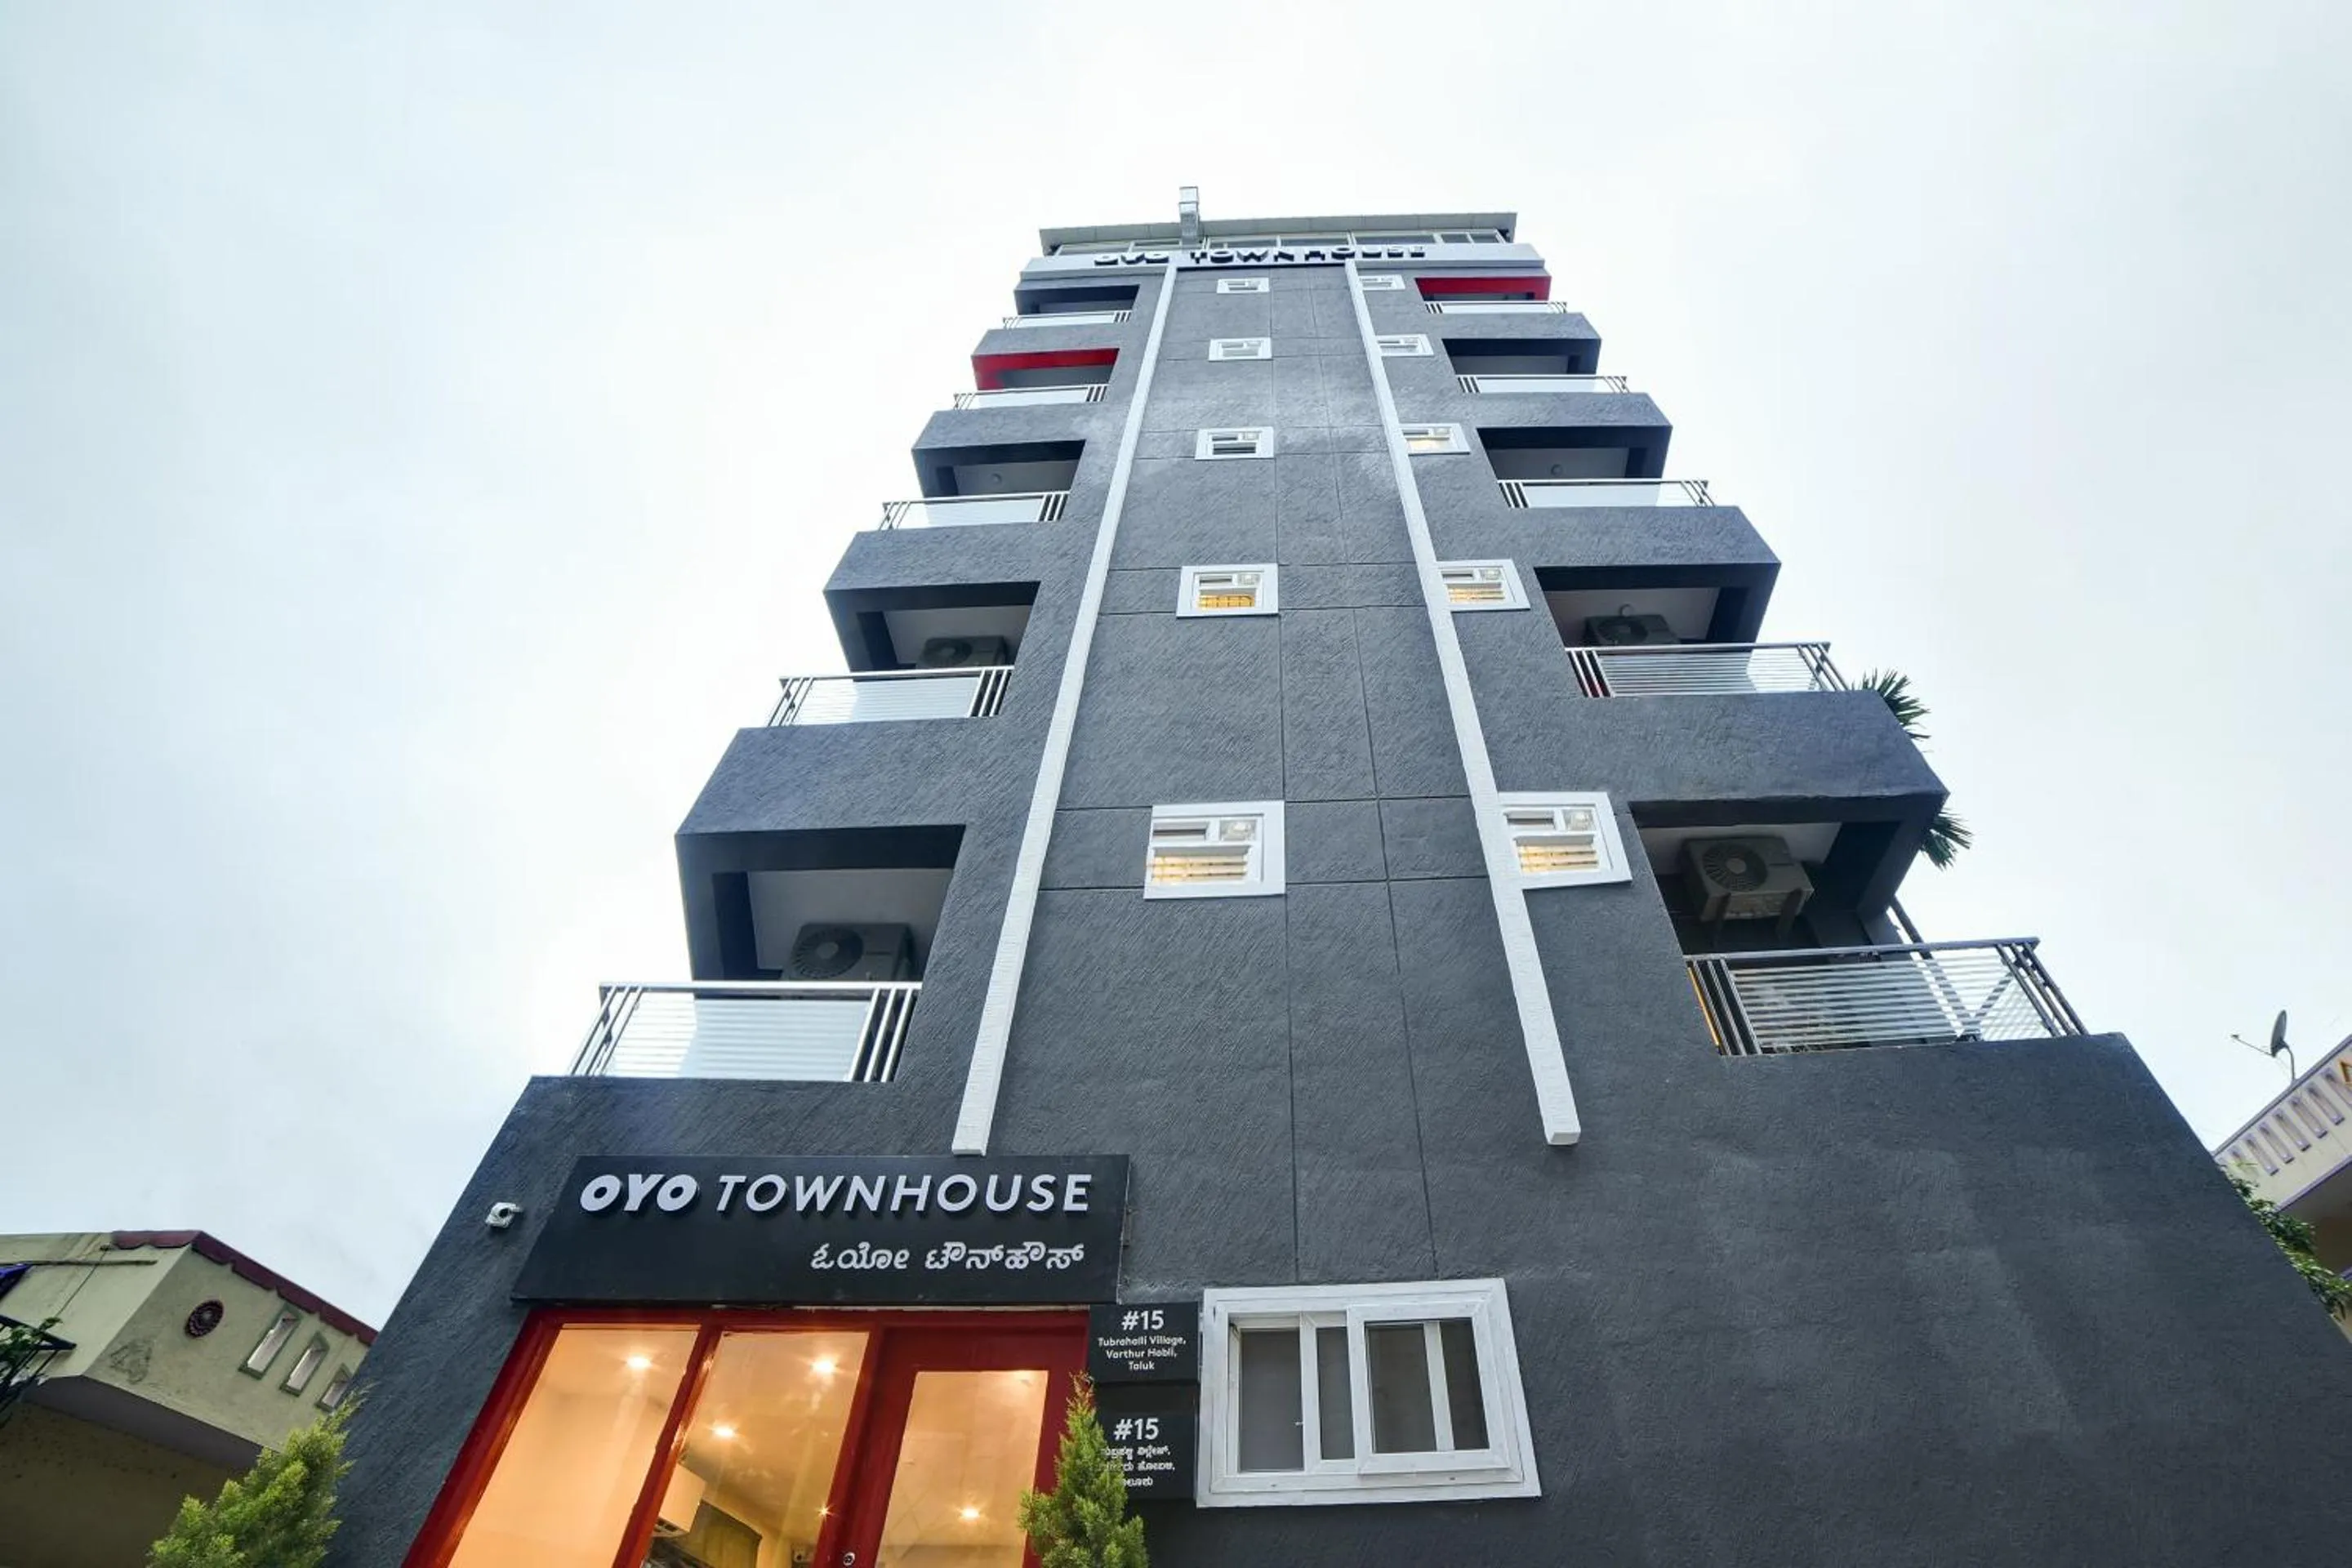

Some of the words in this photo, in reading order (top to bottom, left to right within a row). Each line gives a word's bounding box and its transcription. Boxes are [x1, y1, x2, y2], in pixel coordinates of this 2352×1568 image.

[580, 1174, 700, 1211] OYO
[716, 1174, 1092, 1212] TOWNHOUSE
[810, 1241, 910, 1270] ಓಯೋ
[1121, 1310, 1165, 1331] #15
[1106, 1349, 1145, 1360] Varthur
[1128, 1360, 1155, 1371] Taluk
[1113, 1417, 1160, 1441] #15
